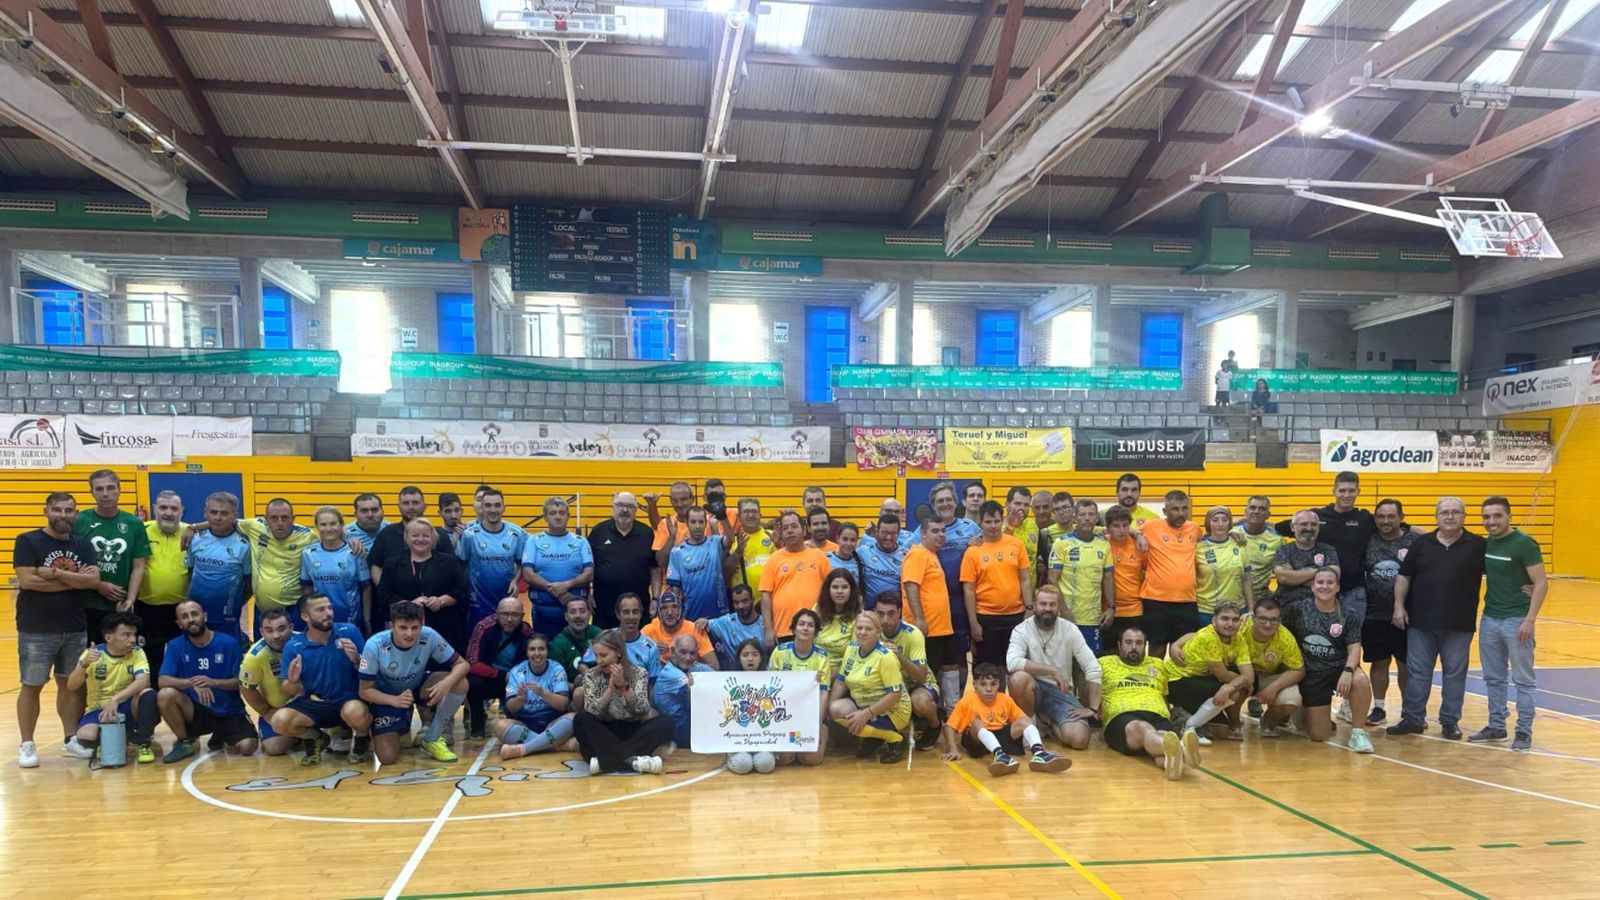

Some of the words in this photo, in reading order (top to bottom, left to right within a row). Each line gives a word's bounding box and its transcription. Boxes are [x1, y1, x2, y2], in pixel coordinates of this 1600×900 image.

[382, 245, 436, 257] cajamar
[672, 233, 697, 260] in
[752, 259, 801, 271] cajamar
[1503, 377, 1539, 396] nex
[27, 434, 43, 446] s.l.
[100, 431, 152, 446] fircosa
[952, 430, 983, 439] Teruel
[987, 432, 993, 440] y
[995, 430, 1028, 440] Miguel
[1117, 440, 1185, 452] INDUSER
[1351, 446, 1433, 467] agroclean
[44, 550, 64, 567] ROCESS
[198, 658, 210, 670] 39
[374, 716, 390, 727] 30
